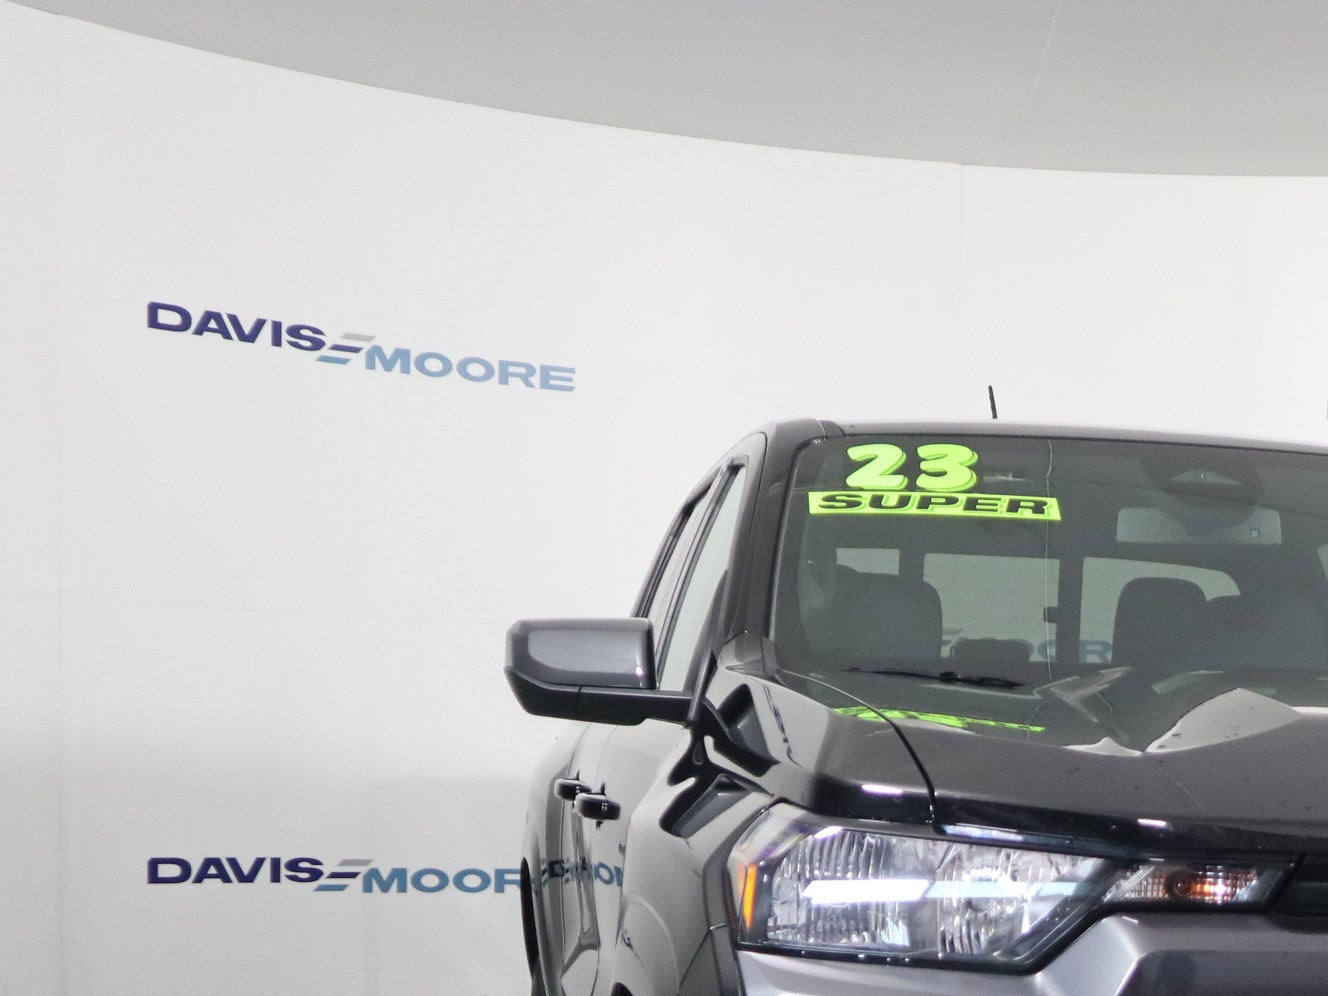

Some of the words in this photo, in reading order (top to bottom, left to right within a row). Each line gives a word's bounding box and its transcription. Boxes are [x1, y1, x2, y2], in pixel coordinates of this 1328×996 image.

[147, 301, 326, 351] DAVIS
[365, 345, 576, 392] MOORE
[845, 443, 978, 492] 23
[817, 493, 1052, 515] SUPER
[147, 857, 324, 884] DAVIS
[362, 867, 521, 893] MOOR
